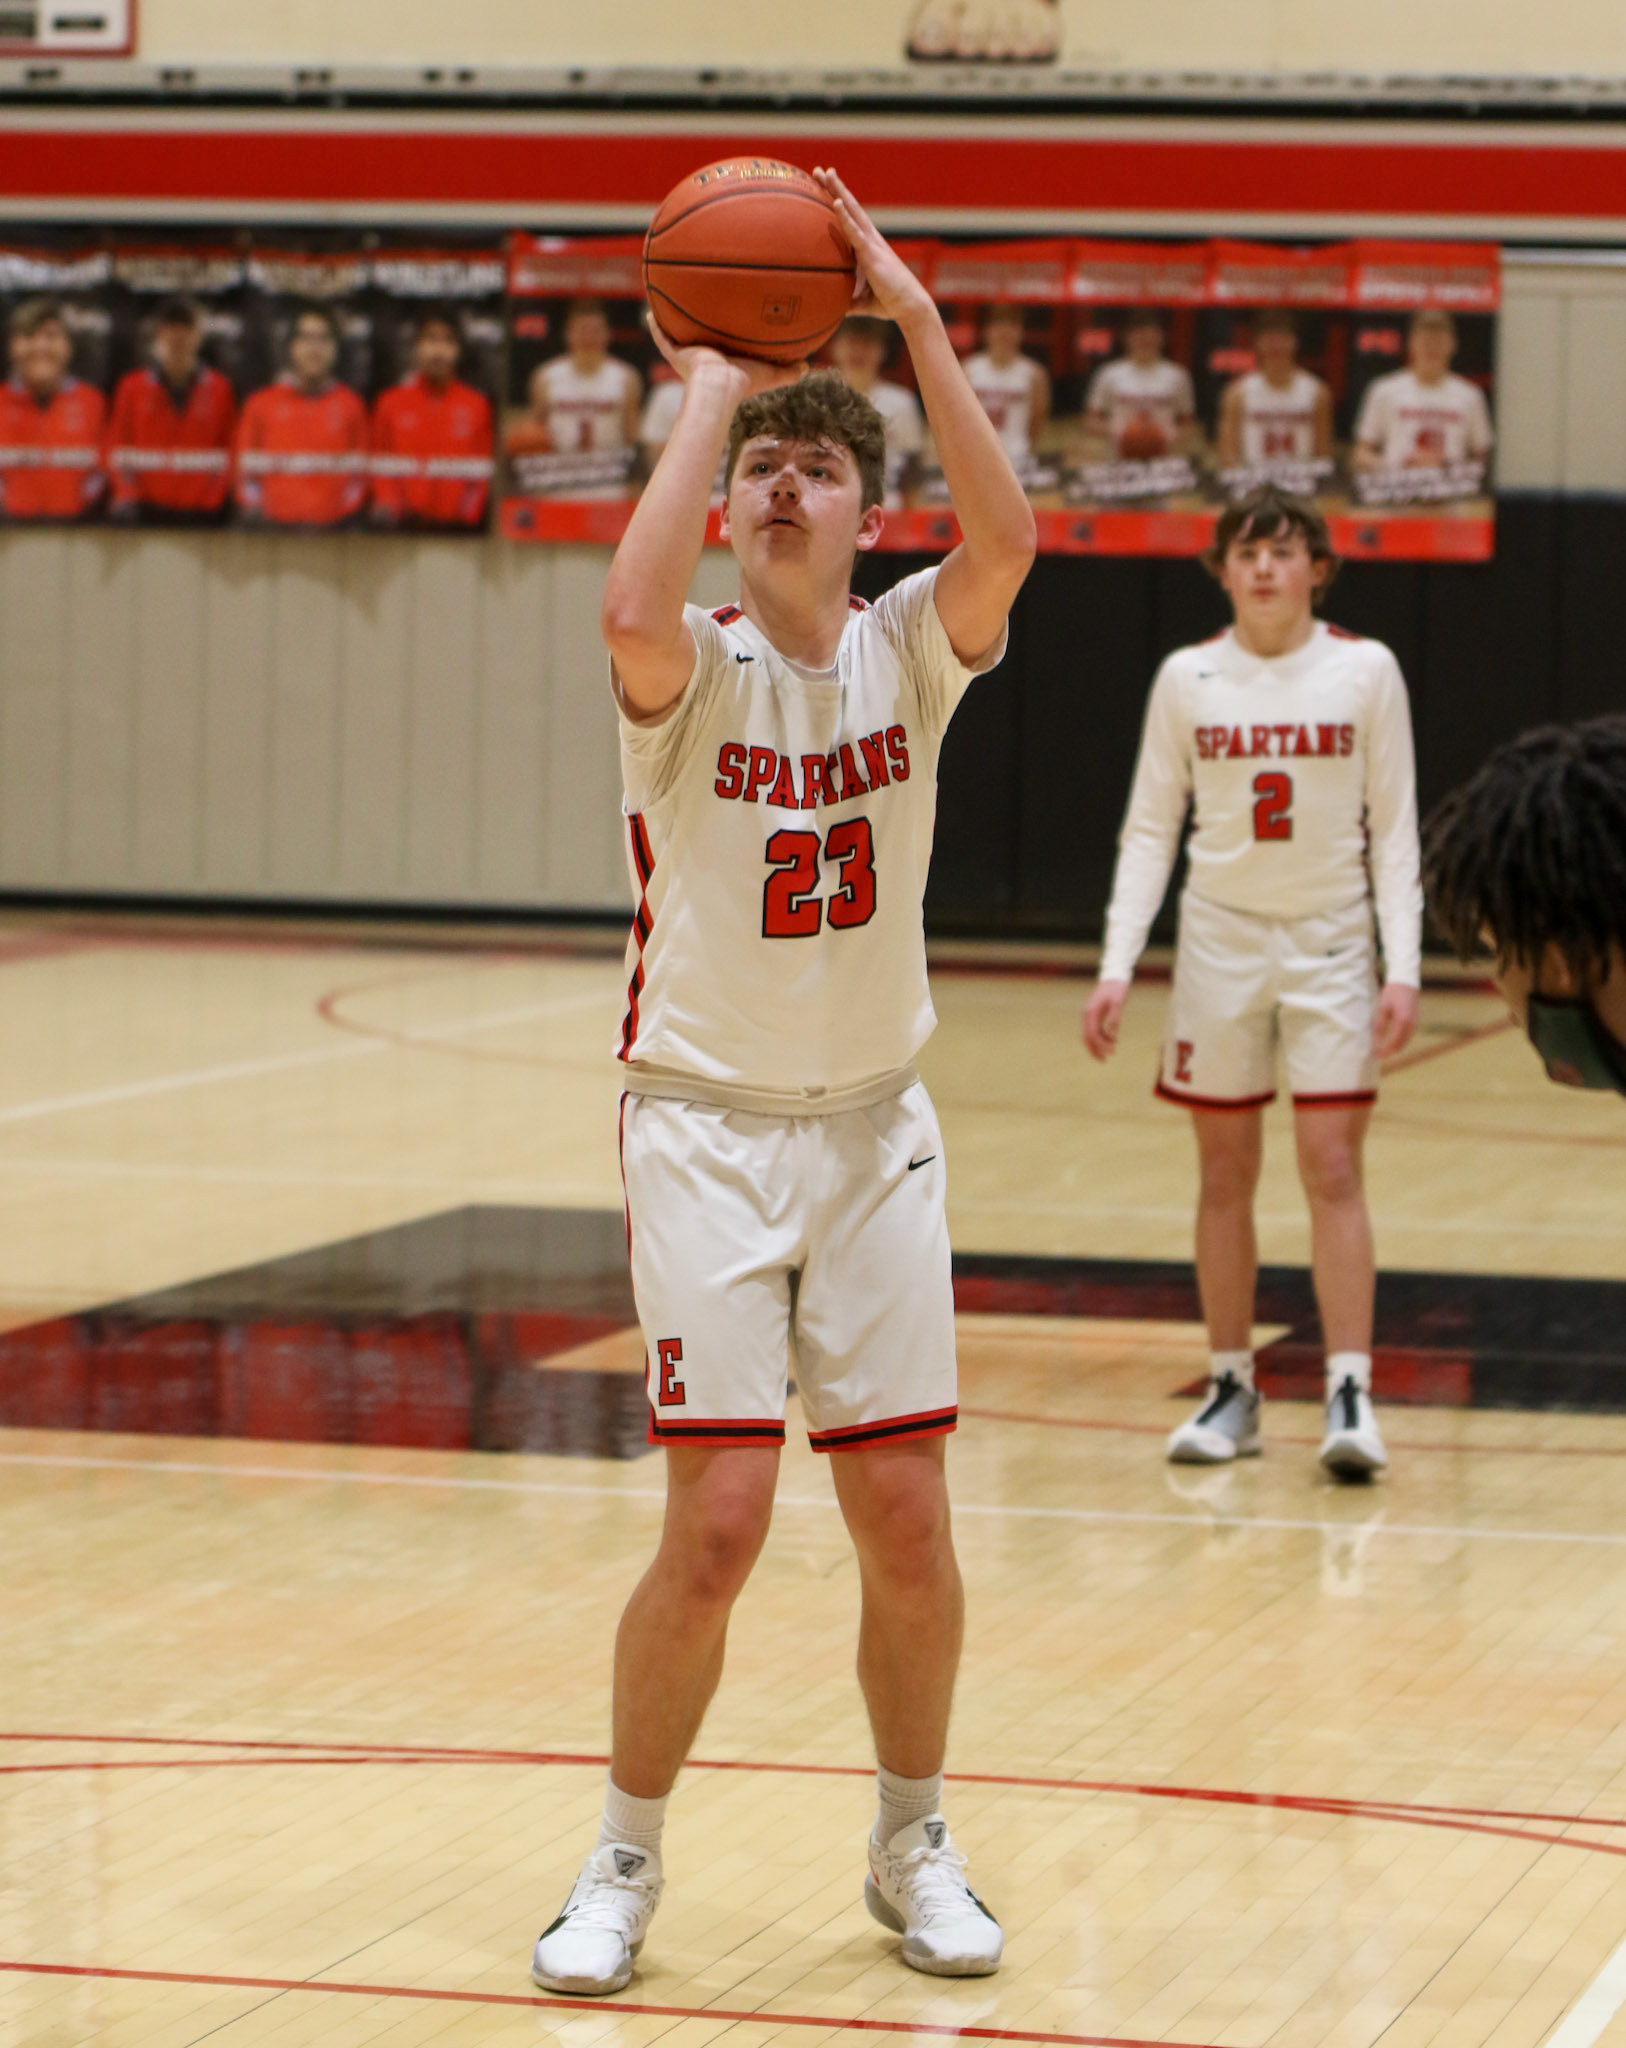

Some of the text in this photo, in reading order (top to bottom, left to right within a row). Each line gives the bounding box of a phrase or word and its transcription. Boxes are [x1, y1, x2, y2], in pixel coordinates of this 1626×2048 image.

[714, 724, 910, 810] SPARTANS
[1194, 724, 1355, 760] SPARTANS
[1252, 772, 1293, 841] 2
[762, 816, 878, 939] 23
[1174, 1039, 1195, 1084] E
[656, 1337, 686, 1406] E
